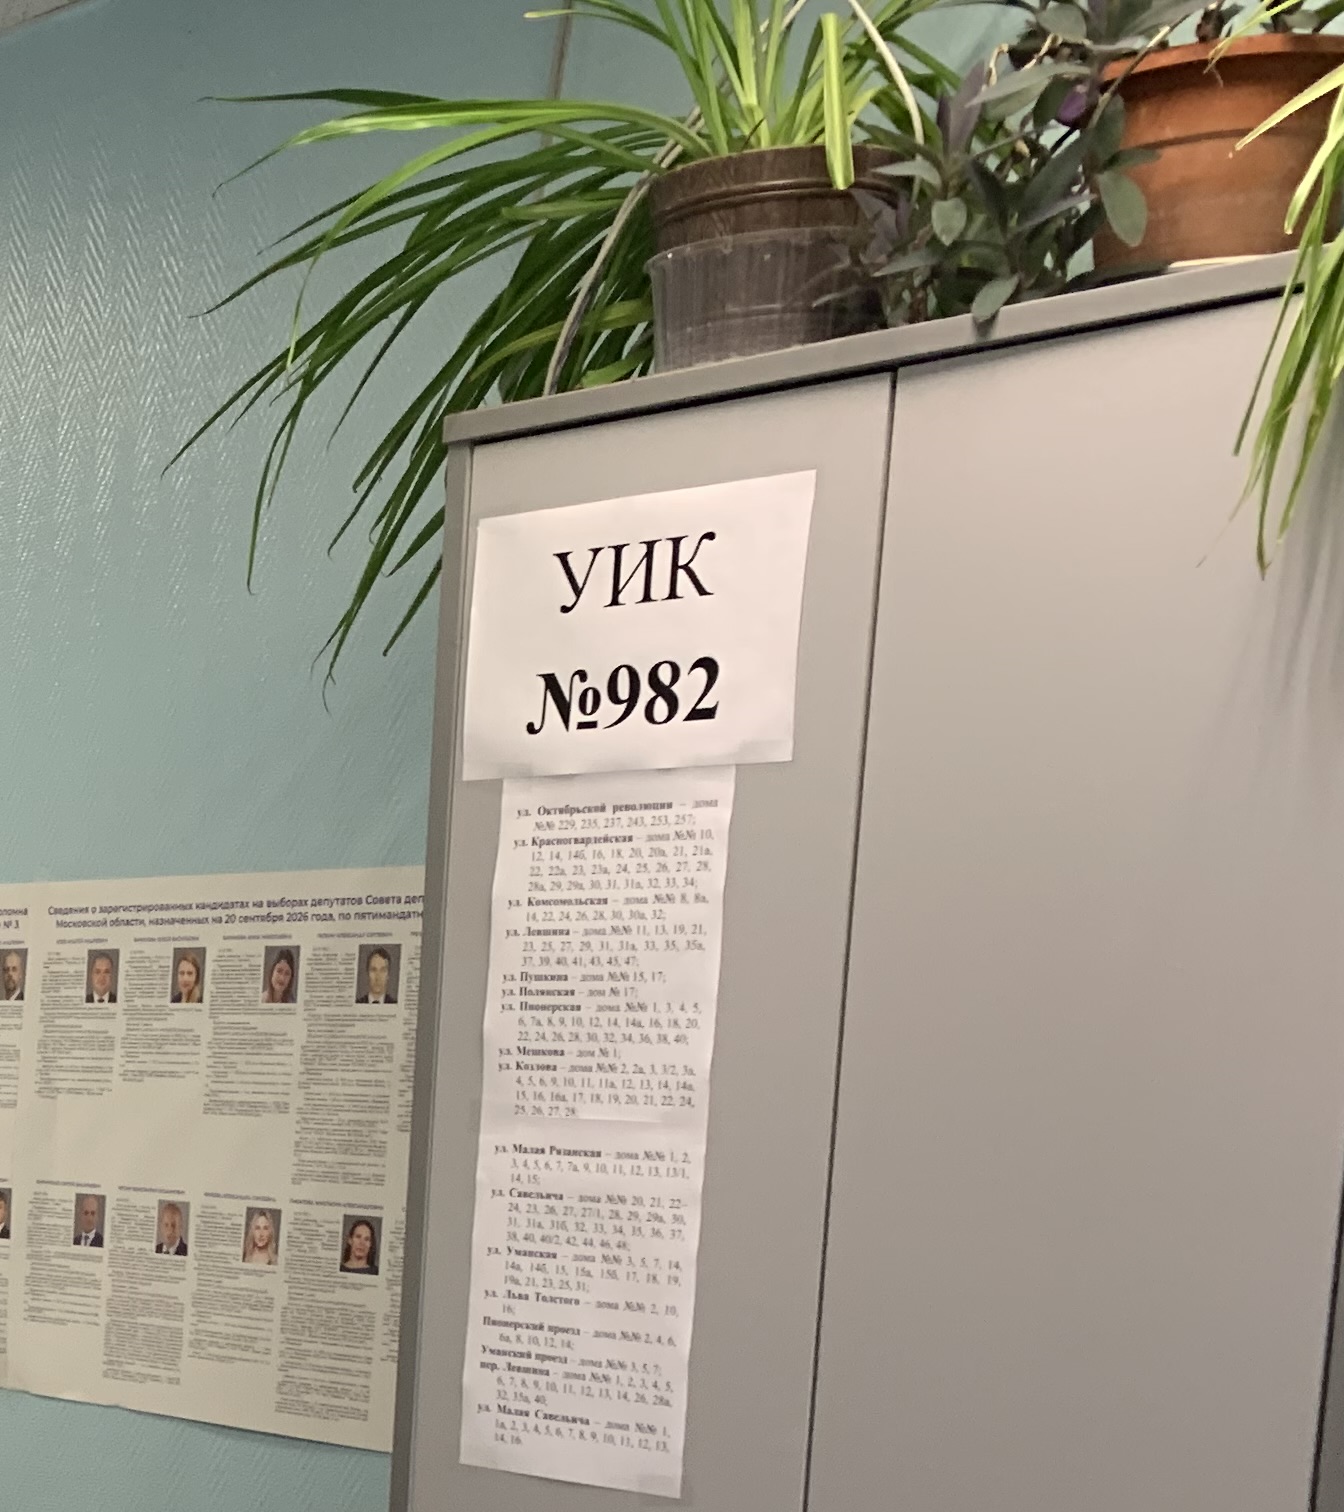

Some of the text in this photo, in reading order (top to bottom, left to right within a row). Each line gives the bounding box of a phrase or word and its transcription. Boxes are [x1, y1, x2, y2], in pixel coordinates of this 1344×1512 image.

[553, 531, 717, 613] УИК
[526, 656, 720, 735] №982
[517, 801, 673, 818] ул. Октябрьской революции
[513, 834, 634, 849] ул. Красногвардейская
[48, 906, 89, 916] Сведения
[99, 903, 193, 914] зарегистрированных
[195, 901, 249, 911] кандидатах
[266, 898, 308, 908] выборах
[311, 898, 363, 908] депутатов
[365, 895, 401, 905] Совета
[508, 896, 608, 909] ул. Комсомольская
[56, 918, 108, 928] Московской
[110, 918, 146, 927] области,
[149, 916, 209, 926] назначенных
[225, 914, 236, 923] 20
[239, 913, 284, 923] сентября
[286, 912, 308, 921] 2026
[311, 913, 336, 921] года,
[505, 927, 570, 938] ул. Левшина
[503, 972, 569, 983] ул. Пушкина
[502, 987, 575, 997] ул. Полянская
[500, 1002, 581, 1014] ул. Пионерская
[499, 1046, 565, 1057] ул. Мешкова
[498, 1061, 557, 1072] ул. Козлова
[494, 1144, 602, 1158] ул. Малая Рязанская
[491, 1188, 564, 1201] ул. Савельича
[487, 1246, 557, 1260] ул. Уманская
[484, 1289, 580, 1306] ул. Льва Толстого
[483, 1316, 580, 1337] Пионерский проезд
[482, 1345, 568, 1365] Уманский проезд
[504, 1362, 550, 1377] Левшина
[497, 1404, 529, 1417] Малая
[535, 1409, 590, 1426] Савельича
